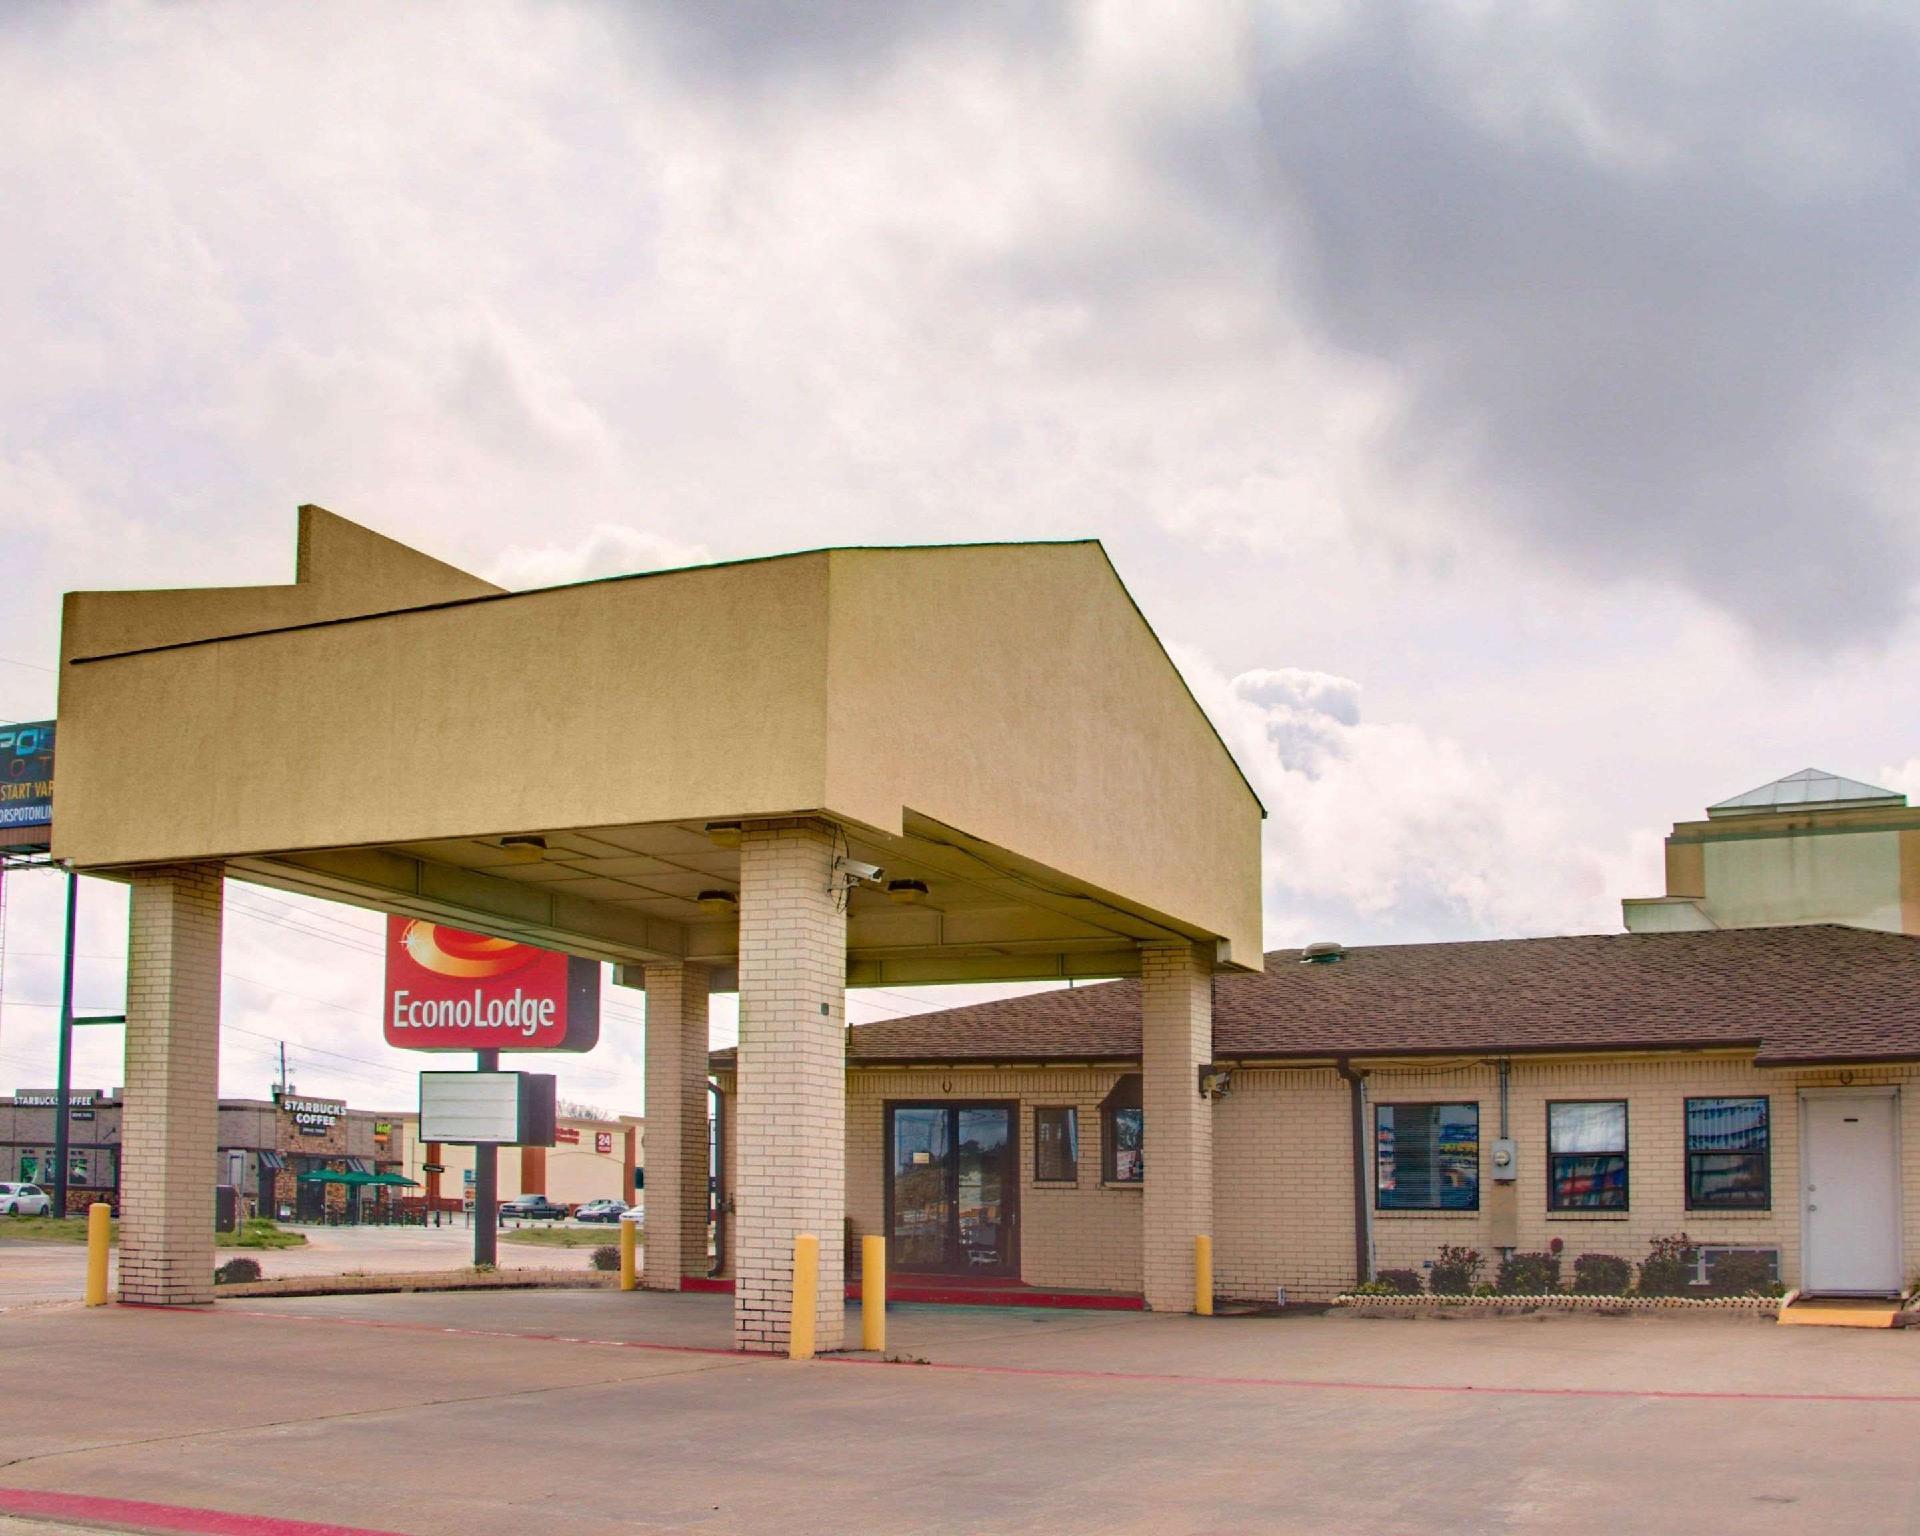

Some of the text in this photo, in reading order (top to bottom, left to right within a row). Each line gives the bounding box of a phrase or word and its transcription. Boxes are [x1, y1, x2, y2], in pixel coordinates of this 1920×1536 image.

[1, 782, 32, 801] START
[393, 988, 555, 1036] EconoLodge
[284, 1100, 347, 1116] STARBUCKS
[296, 1112, 336, 1126] COFFEE
[598, 1134, 610, 1146] 24
